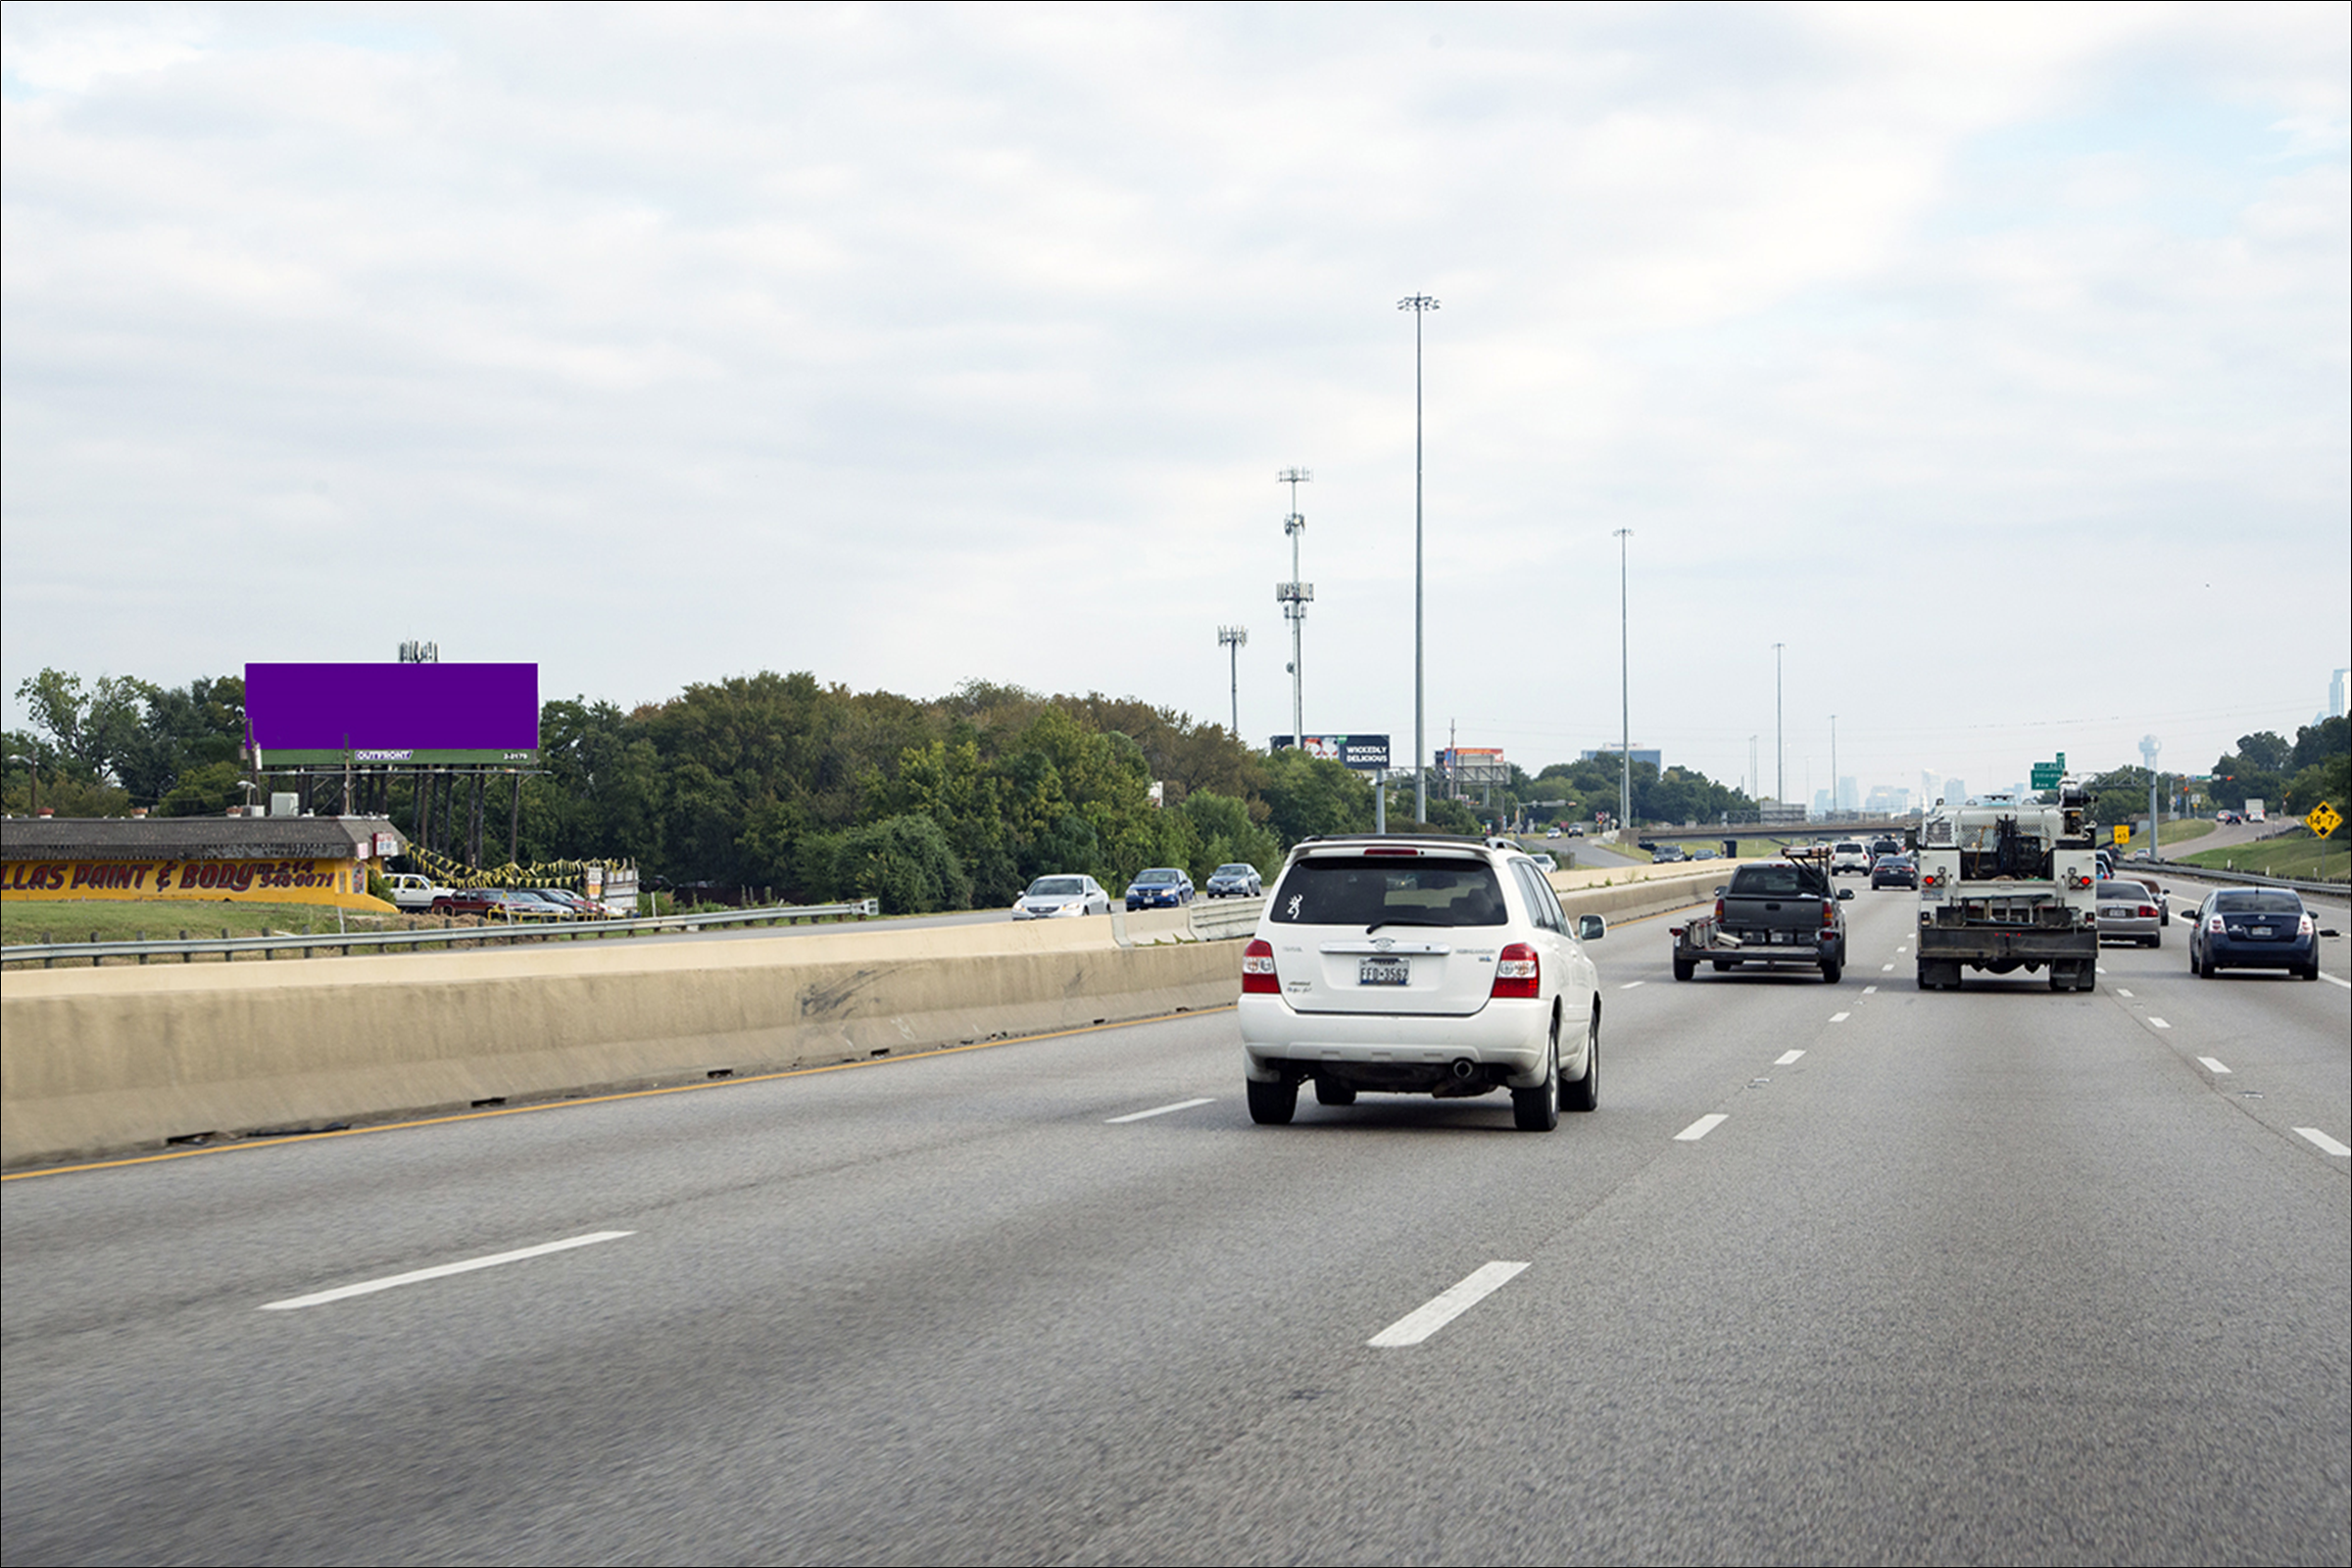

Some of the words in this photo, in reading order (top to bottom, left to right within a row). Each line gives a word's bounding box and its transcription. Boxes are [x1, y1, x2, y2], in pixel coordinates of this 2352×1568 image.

[1346, 745, 1388, 754] WICKEDLY
[70, 863, 154, 890] PAINT
[155, 860, 178, 893] &
[178, 862, 258, 893] BODY
[258, 872, 336, 888] 948-0071
